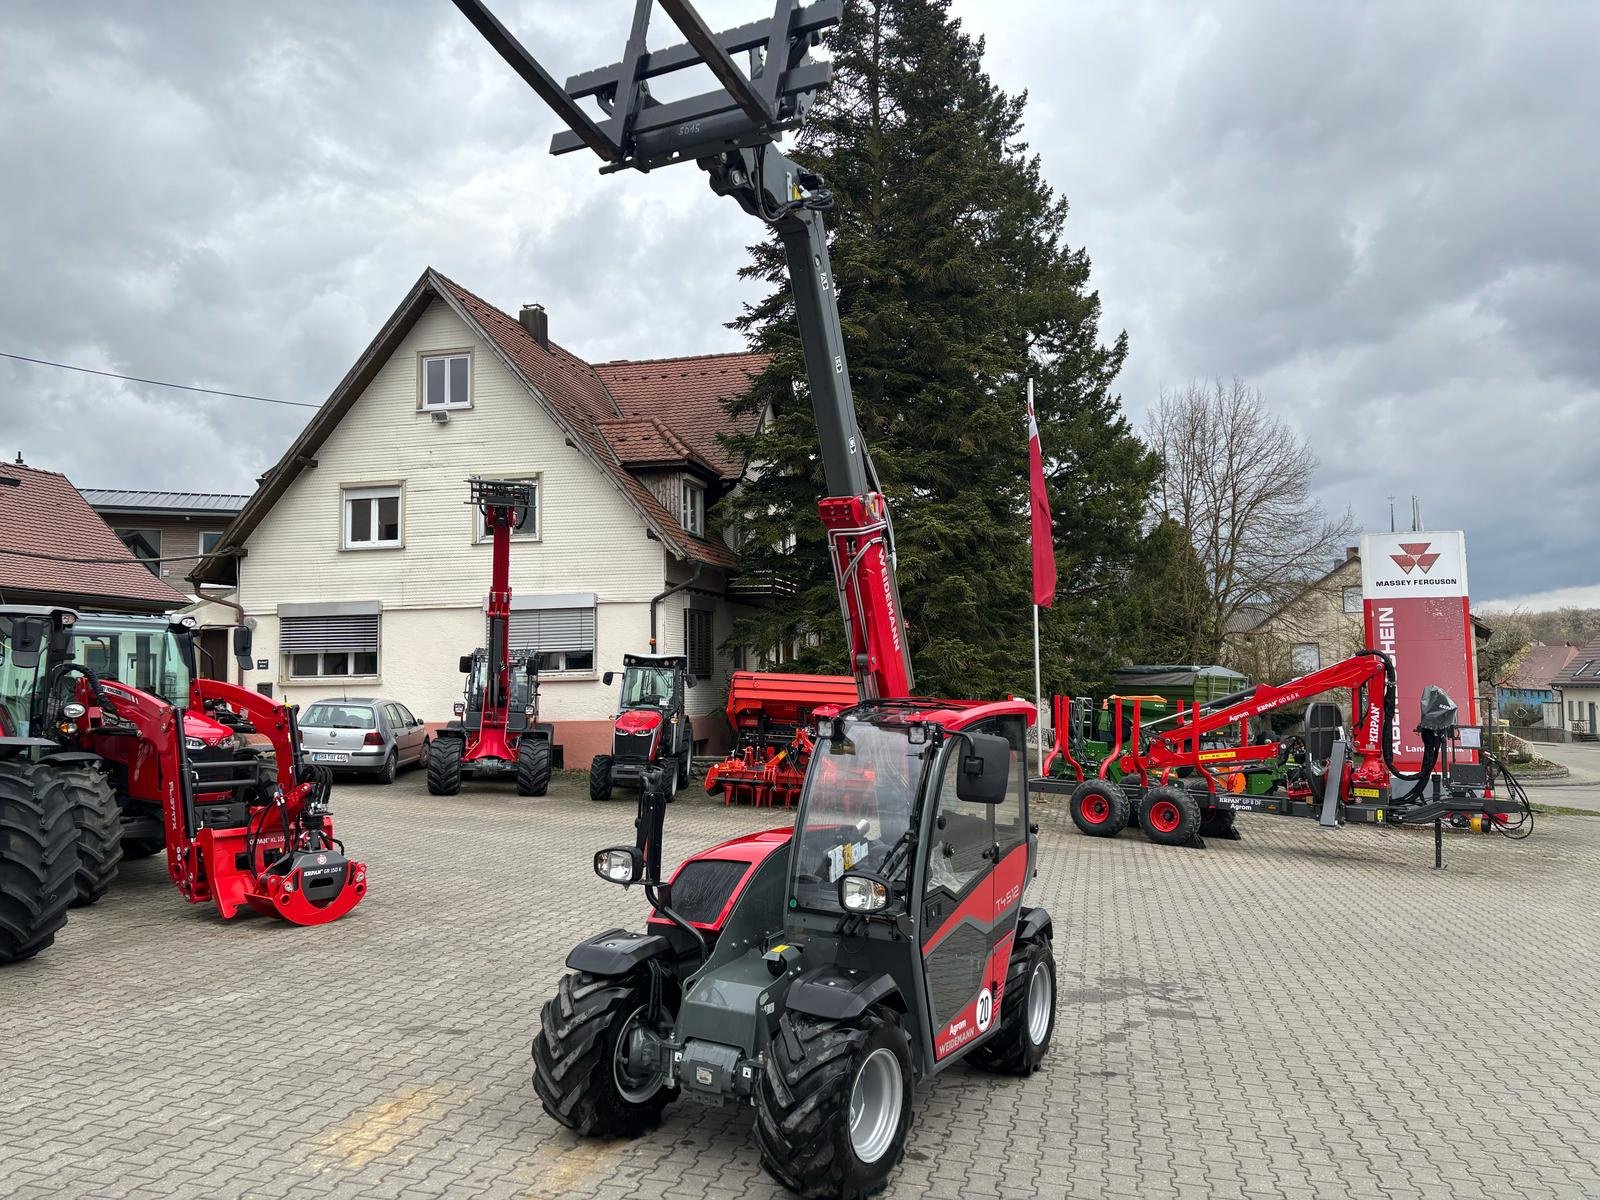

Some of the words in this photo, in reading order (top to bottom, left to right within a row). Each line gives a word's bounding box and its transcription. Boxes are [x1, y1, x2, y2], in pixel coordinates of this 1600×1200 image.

[1413, 578, 1457, 586] FERGUSON
[878, 546, 901, 653] WEIDEMANN
[1229, 711, 1250, 722] Agrom
[1369, 702, 1381, 744] KRPAN
[1230, 803, 1252, 811] Agrom
[979, 995, 989, 1025] 20
[949, 1019, 967, 1037] Agrom
[938, 1026, 975, 1056] WEIDEMANN
